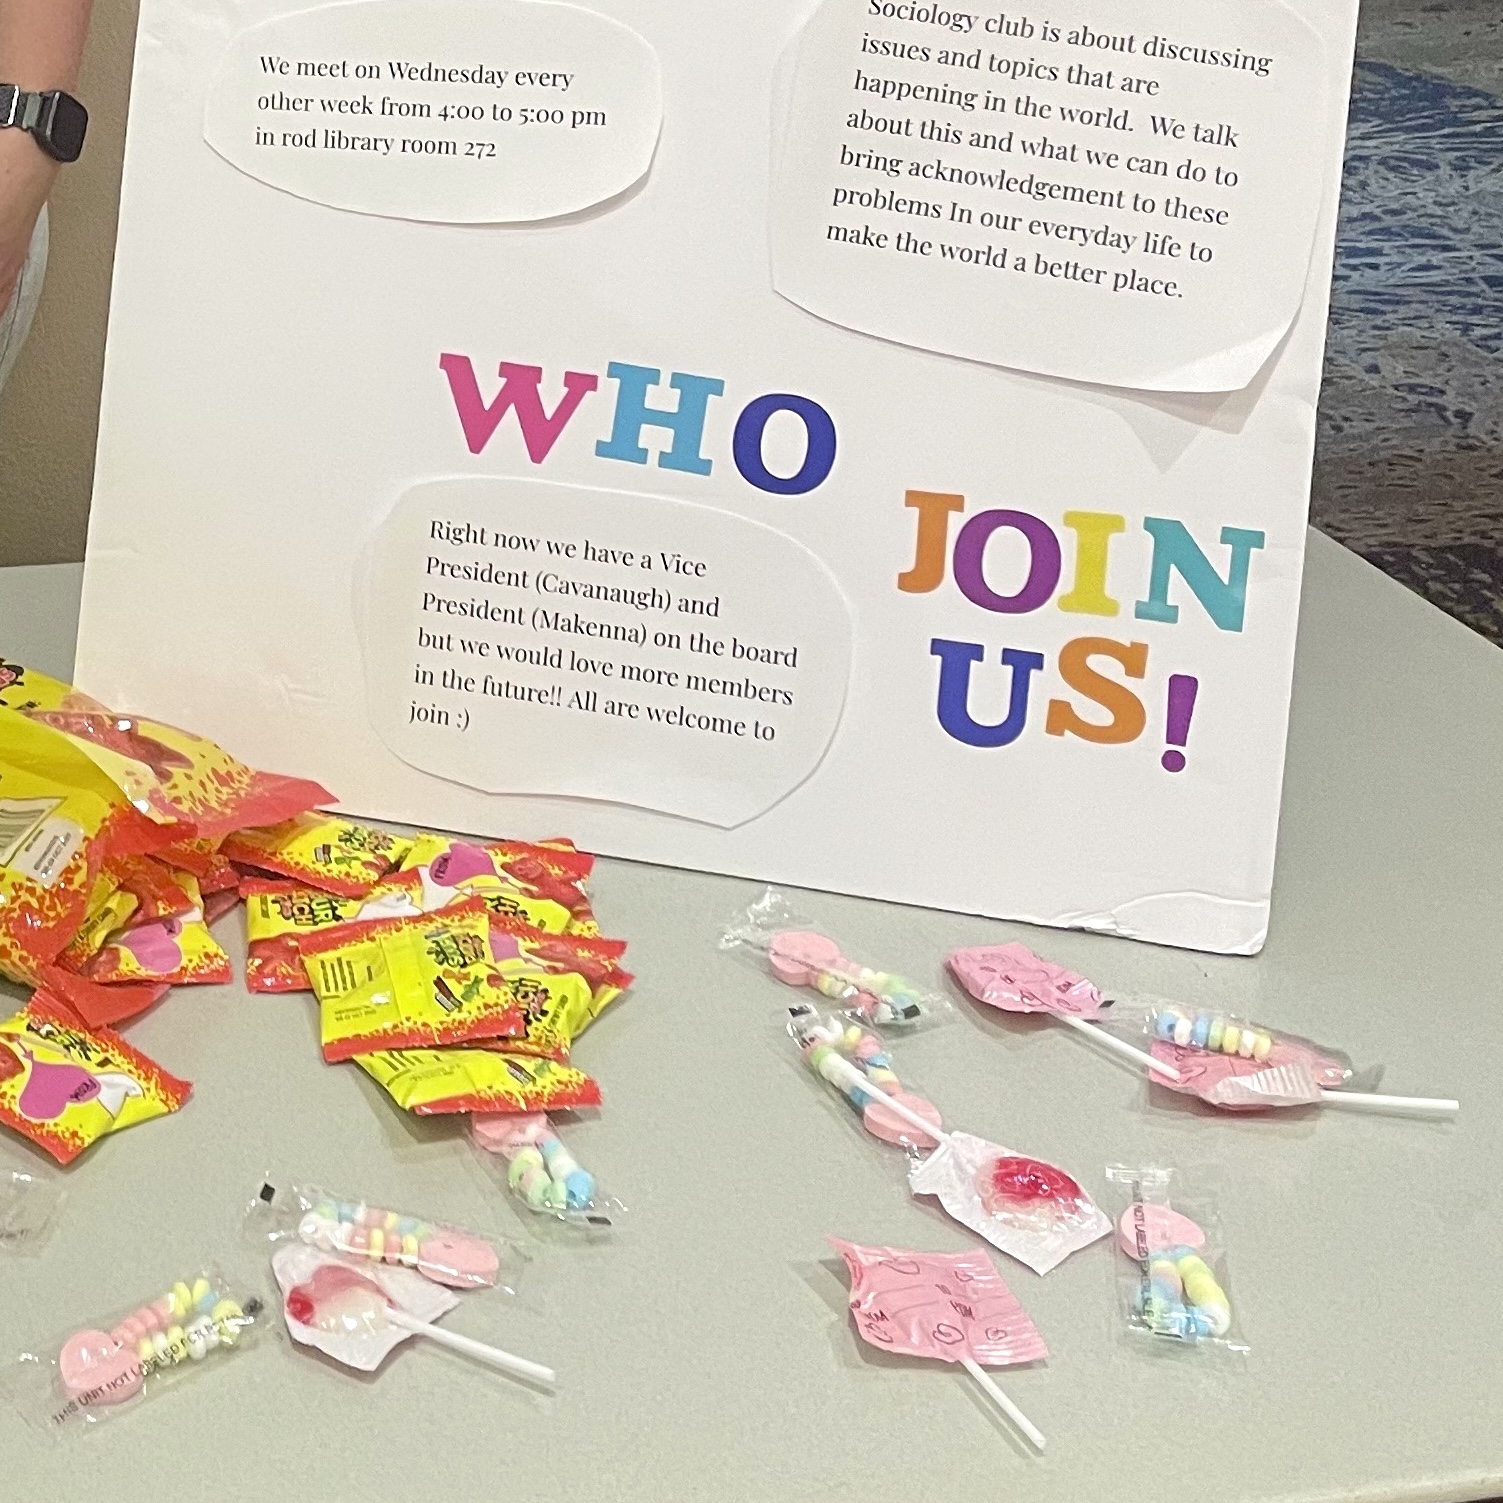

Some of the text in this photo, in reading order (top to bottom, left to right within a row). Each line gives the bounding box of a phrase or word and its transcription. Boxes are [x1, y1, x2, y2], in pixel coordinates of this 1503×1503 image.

[260, 55, 575, 92] We meet on Wednesday every
[860, 32, 1160, 97] issues and topics that are
[984, 12, 1035, 39] club
[1040, 20, 1062, 43] is
[1066, 24, 1137, 54] about
[1142, 35, 1274, 78] discussing
[254, 125, 497, 161] in rod library room 272
[257, 90, 607, 130] other week from 4:00 to 5:00 pm
[852, 68, 1240, 149] happening in the world. We talk
[839, 143, 1229, 226] bring acknowledgement to these
[846, 107, 1239, 188] about this and what we can do to
[826, 224, 1183, 299] make the world a better place.
[832, 187, 1213, 263] problems In our everyday life to
[439, 352, 837, 496] WHO
[429, 519, 707, 578] Right now we have a Vice
[897, 489, 1266, 633] JOIN
[426, 555, 721, 619] President (Cavanaugh) and
[418, 626, 794, 707] but we would love more members
[421, 591, 798, 669] President (Makenna) on the board
[408, 699, 470, 733] join :)
[412, 663, 776, 742] in the future!! All are welcome to
[930, 636, 1199, 773] US!
[52, 1400, 79, 1425] THIS
[78, 1384, 106, 1407] UNIT
[106, 1372, 131, 1393] NOT
